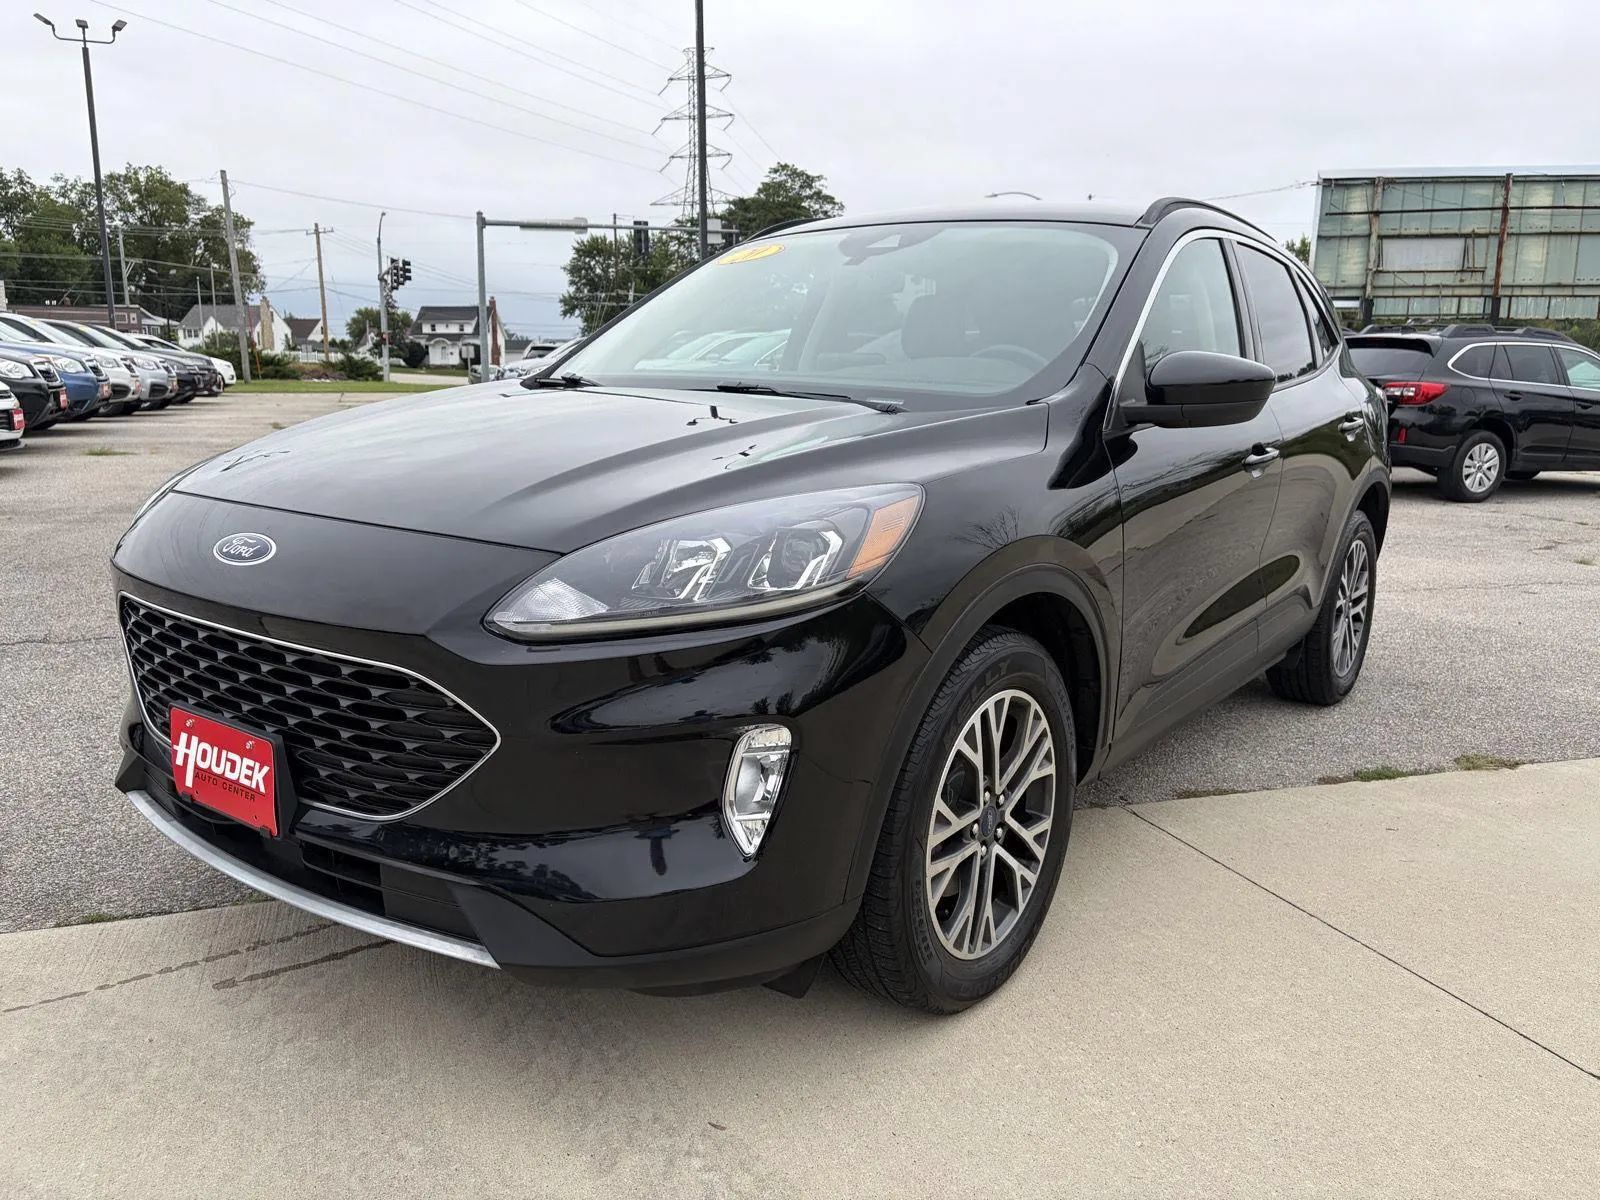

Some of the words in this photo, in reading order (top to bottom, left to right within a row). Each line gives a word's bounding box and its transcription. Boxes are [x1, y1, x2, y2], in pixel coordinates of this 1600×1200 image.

[222, 536, 260, 557] Ford
[173, 731, 270, 794] HOUDEK
[195, 772, 218, 787] AUTO
[222, 781, 256, 802] CENTER
